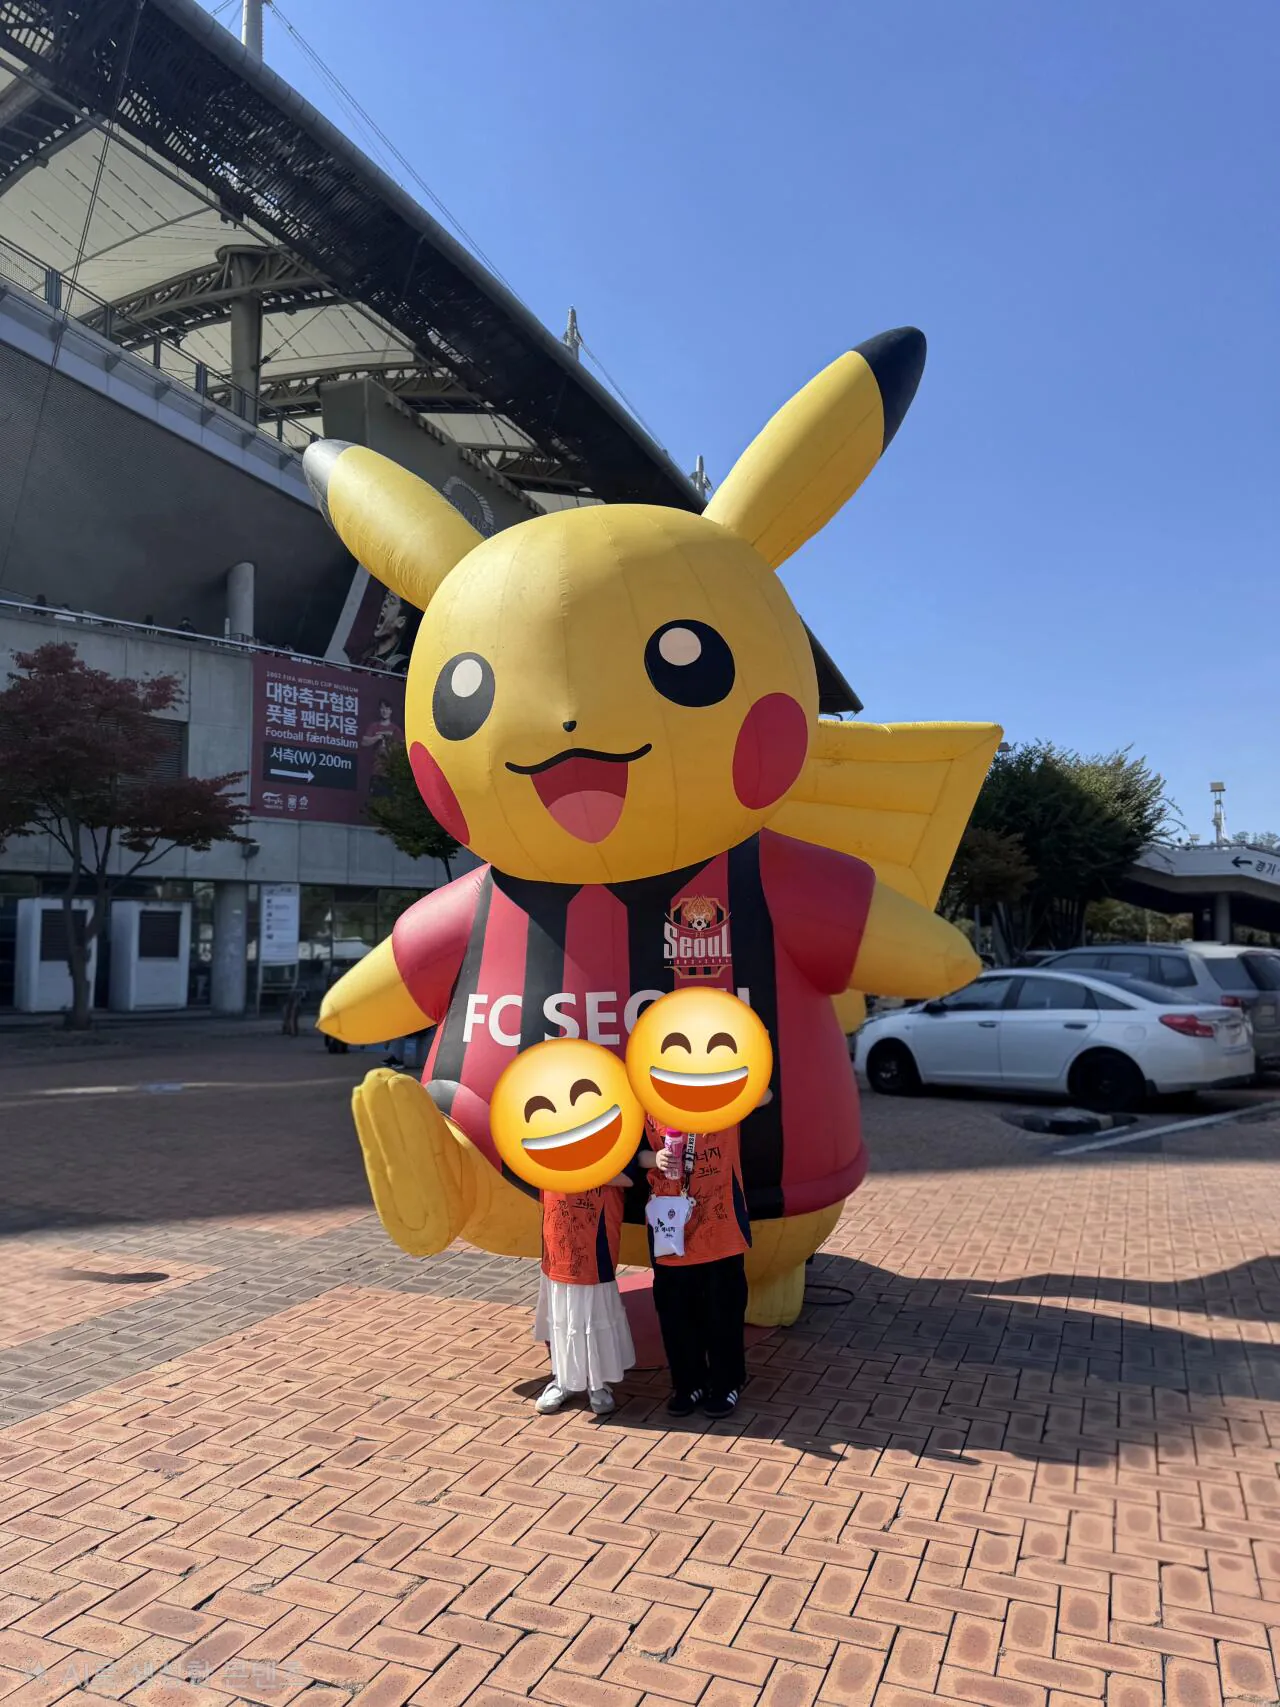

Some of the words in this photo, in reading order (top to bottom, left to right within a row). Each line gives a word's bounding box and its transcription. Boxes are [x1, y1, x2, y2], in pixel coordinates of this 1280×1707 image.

[266, 670, 281, 679] 2002
[298, 677, 319, 686] WORLD
[333, 683, 359, 693] MUSEUM
[266, 682, 359, 716] 대한축구협회
[265, 726, 304, 741] Football
[266, 704, 298, 727] 풋볼
[301, 710, 359, 736] 팬타지움
[270, 746, 316, 767] 서측(W)
[318, 753, 352, 769] 200m
[462, 993, 523, 1046] FC
